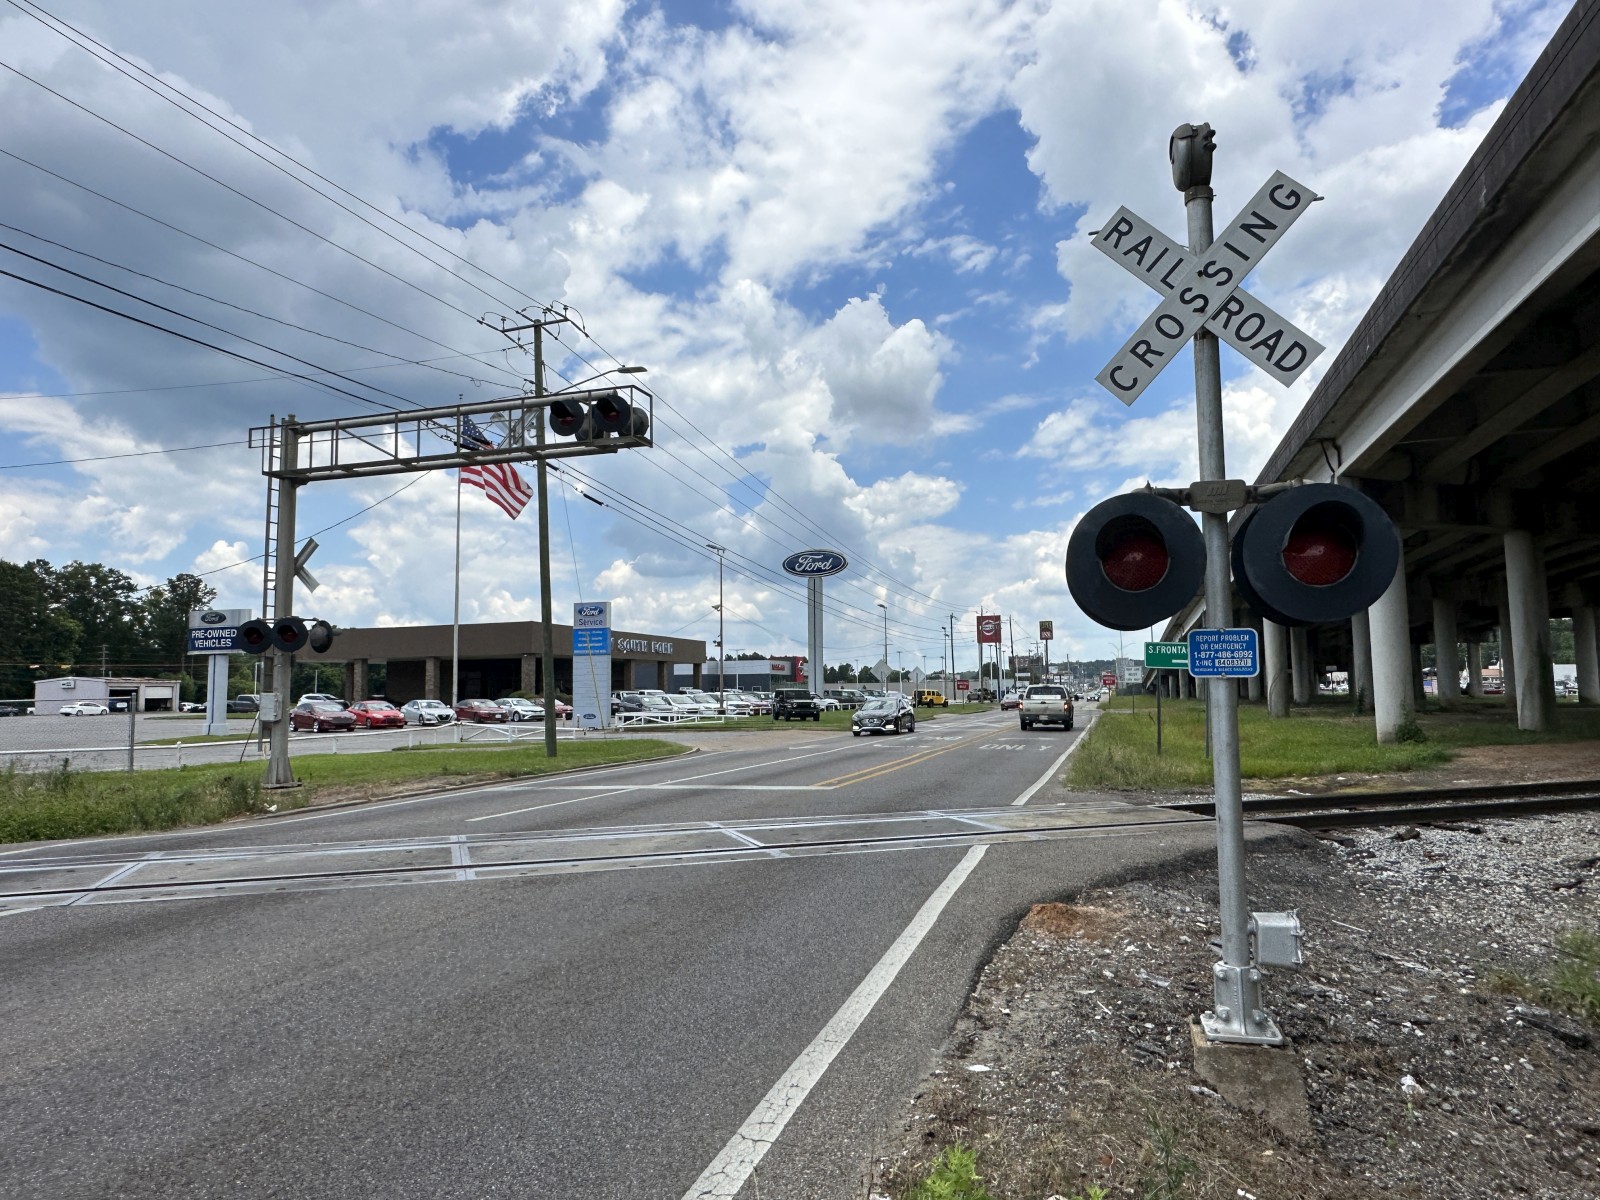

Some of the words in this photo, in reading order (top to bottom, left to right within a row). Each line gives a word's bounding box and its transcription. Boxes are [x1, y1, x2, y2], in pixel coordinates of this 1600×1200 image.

[1109, 183, 1301, 392] CROSSING
[1102, 216, 1184, 290] RAIL
[1211, 294, 1307, 373] ROAD
[795, 555, 834, 572] Ford
[581, 606, 599, 616] Ford
[578, 618, 603, 626] Service
[191, 629, 237, 639] PRE-OWNED
[1220, 634, 1249, 642] PROBLEM
[194, 638, 232, 648] VEHICLES
[617, 638, 648, 652] SOUTH
